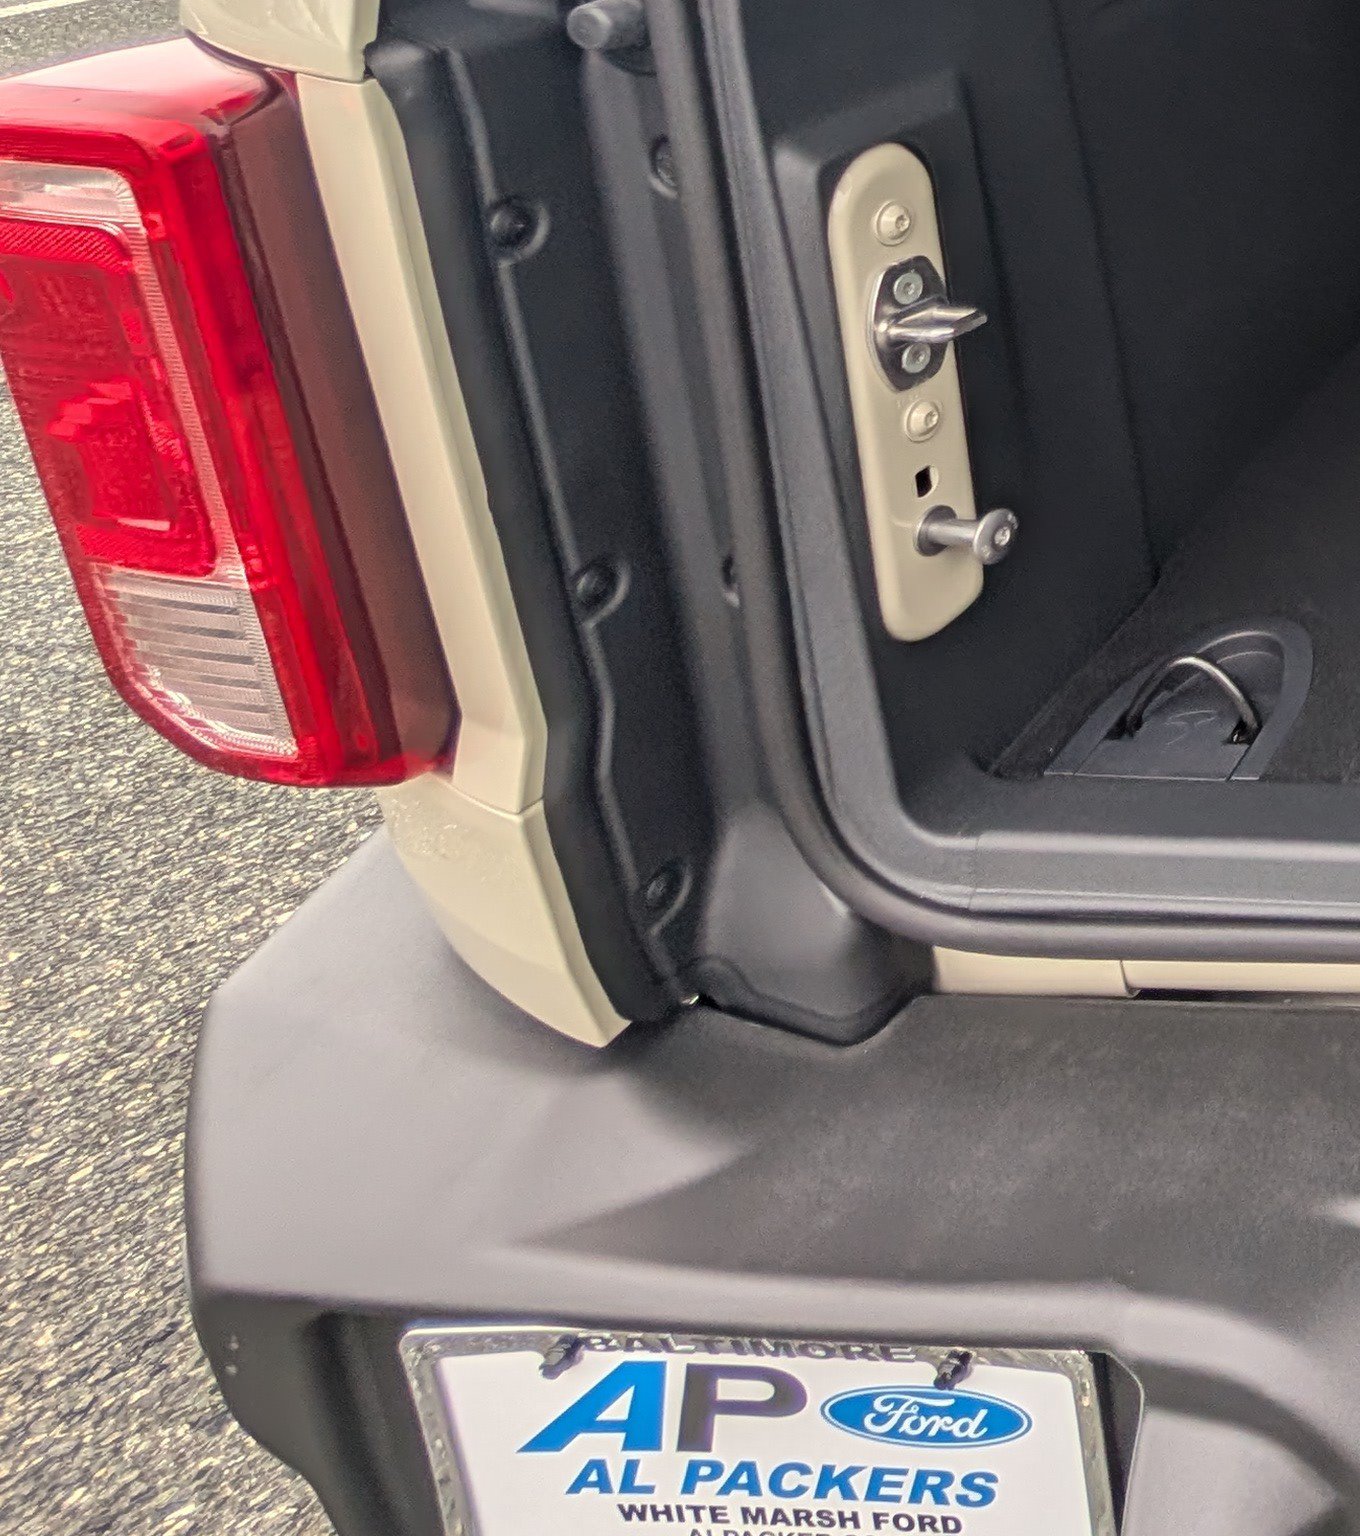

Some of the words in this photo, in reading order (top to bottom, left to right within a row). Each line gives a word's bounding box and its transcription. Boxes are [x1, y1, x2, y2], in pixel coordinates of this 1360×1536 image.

[580, 1333, 917, 1362] BALTIMORE
[515, 1360, 808, 1453] AP
[863, 1393, 989, 1440] Ford
[565, 1458, 657, 1495] AL
[680, 1458, 999, 1509] PACKERS
[617, 1503, 731, 1525] WHITE
[740, 1506, 861, 1530] MARSH
[872, 1512, 963, 1535] FORD
